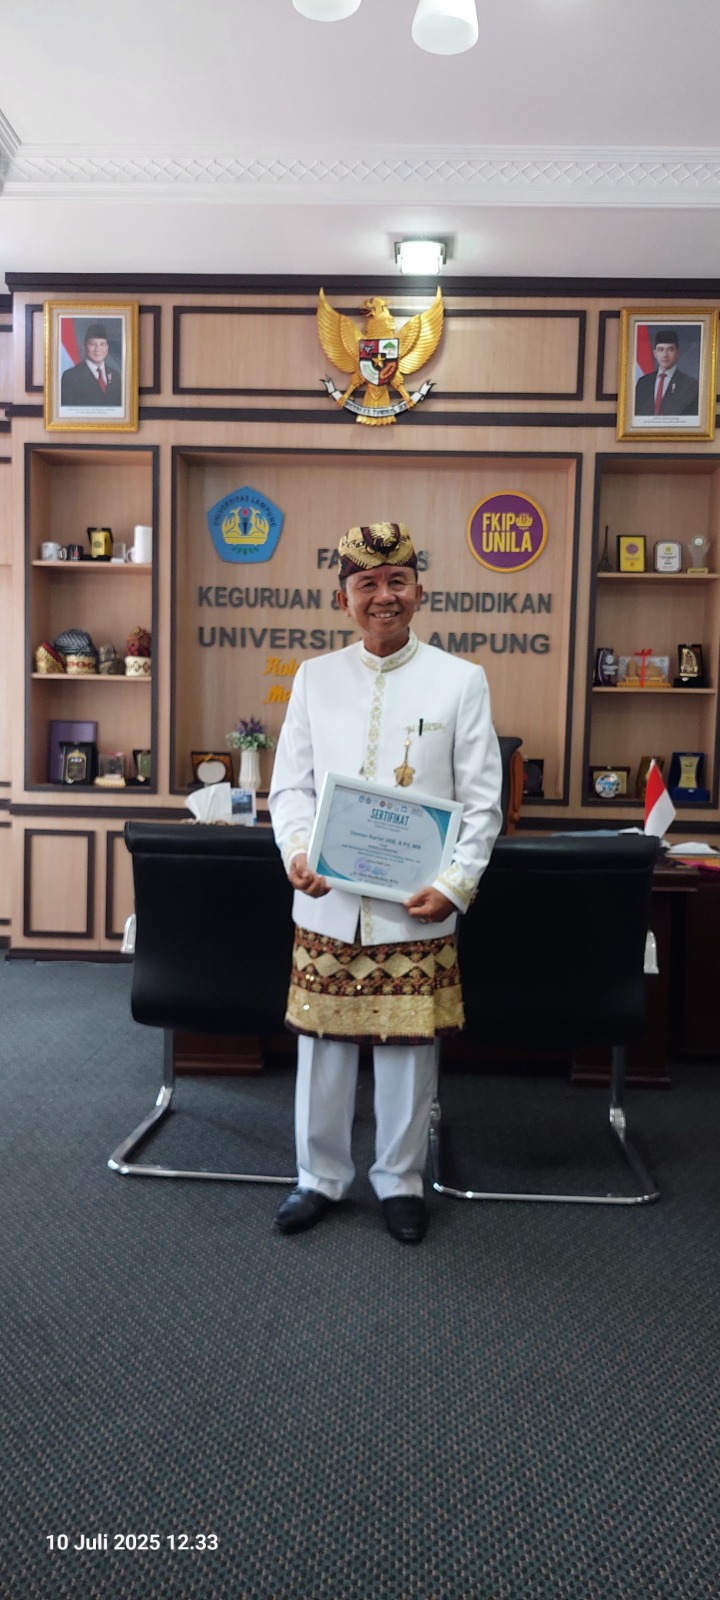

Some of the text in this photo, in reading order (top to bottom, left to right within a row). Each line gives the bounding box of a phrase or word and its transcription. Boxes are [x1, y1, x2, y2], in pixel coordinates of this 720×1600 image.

[482, 512, 516, 532] FKIP
[482, 531, 532, 553] UNILA
[198, 586, 321, 609] KEGURUAN
[416, 591, 552, 614] PENDIDIKAN
[198, 626, 551, 655] UNIVERSIT AMPUNG
[370, 808, 410, 826] SERTIFIKAT
